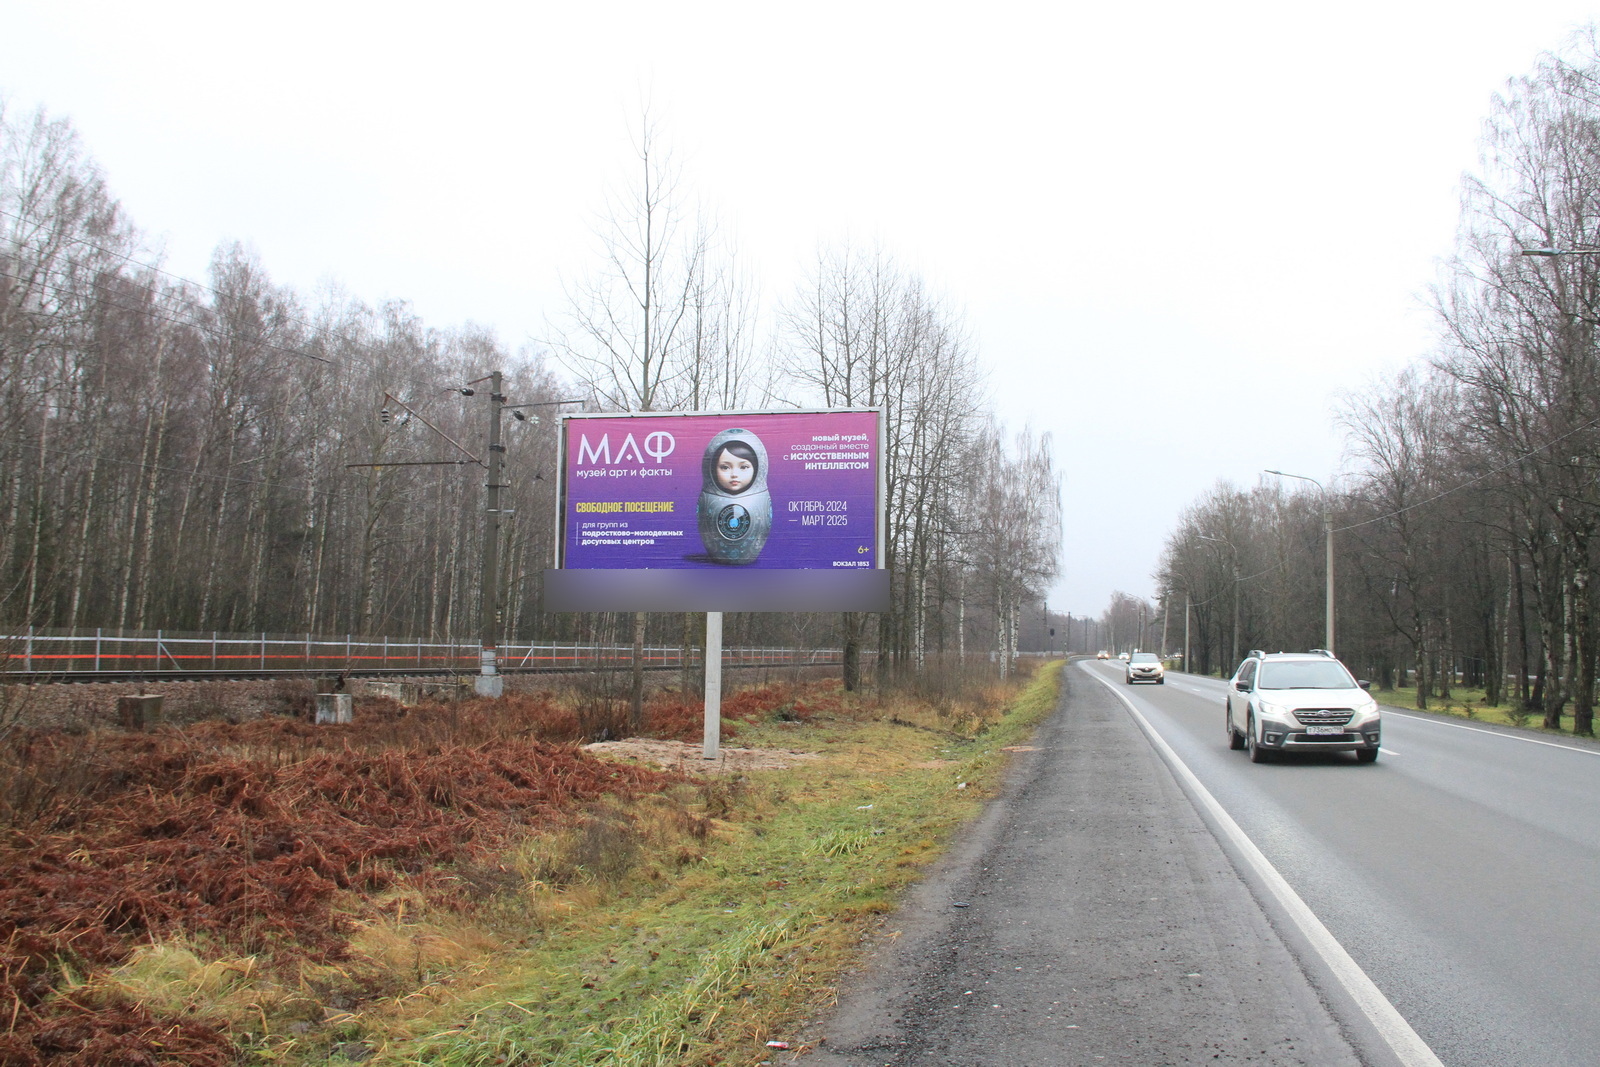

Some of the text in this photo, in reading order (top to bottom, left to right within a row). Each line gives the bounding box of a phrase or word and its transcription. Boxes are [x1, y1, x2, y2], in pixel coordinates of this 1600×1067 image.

[842, 434, 869, 442] музей,
[577, 431, 676, 464] МАФ
[790, 452, 869, 460] ИСКУССТВЕННЫМ
[577, 468, 606, 479] музей
[609, 468, 628, 478] арт
[640, 468, 672, 478] факты
[576, 502, 674, 513] СВОБОДНОЕ ПОСЕЩЕНИЕ
[789, 501, 847, 512] ОКТЯБРЬ 2024
[802, 515, 825, 526] МАРТ
[826, 515, 848, 526] 2025
[857, 546, 869, 554] 6+
